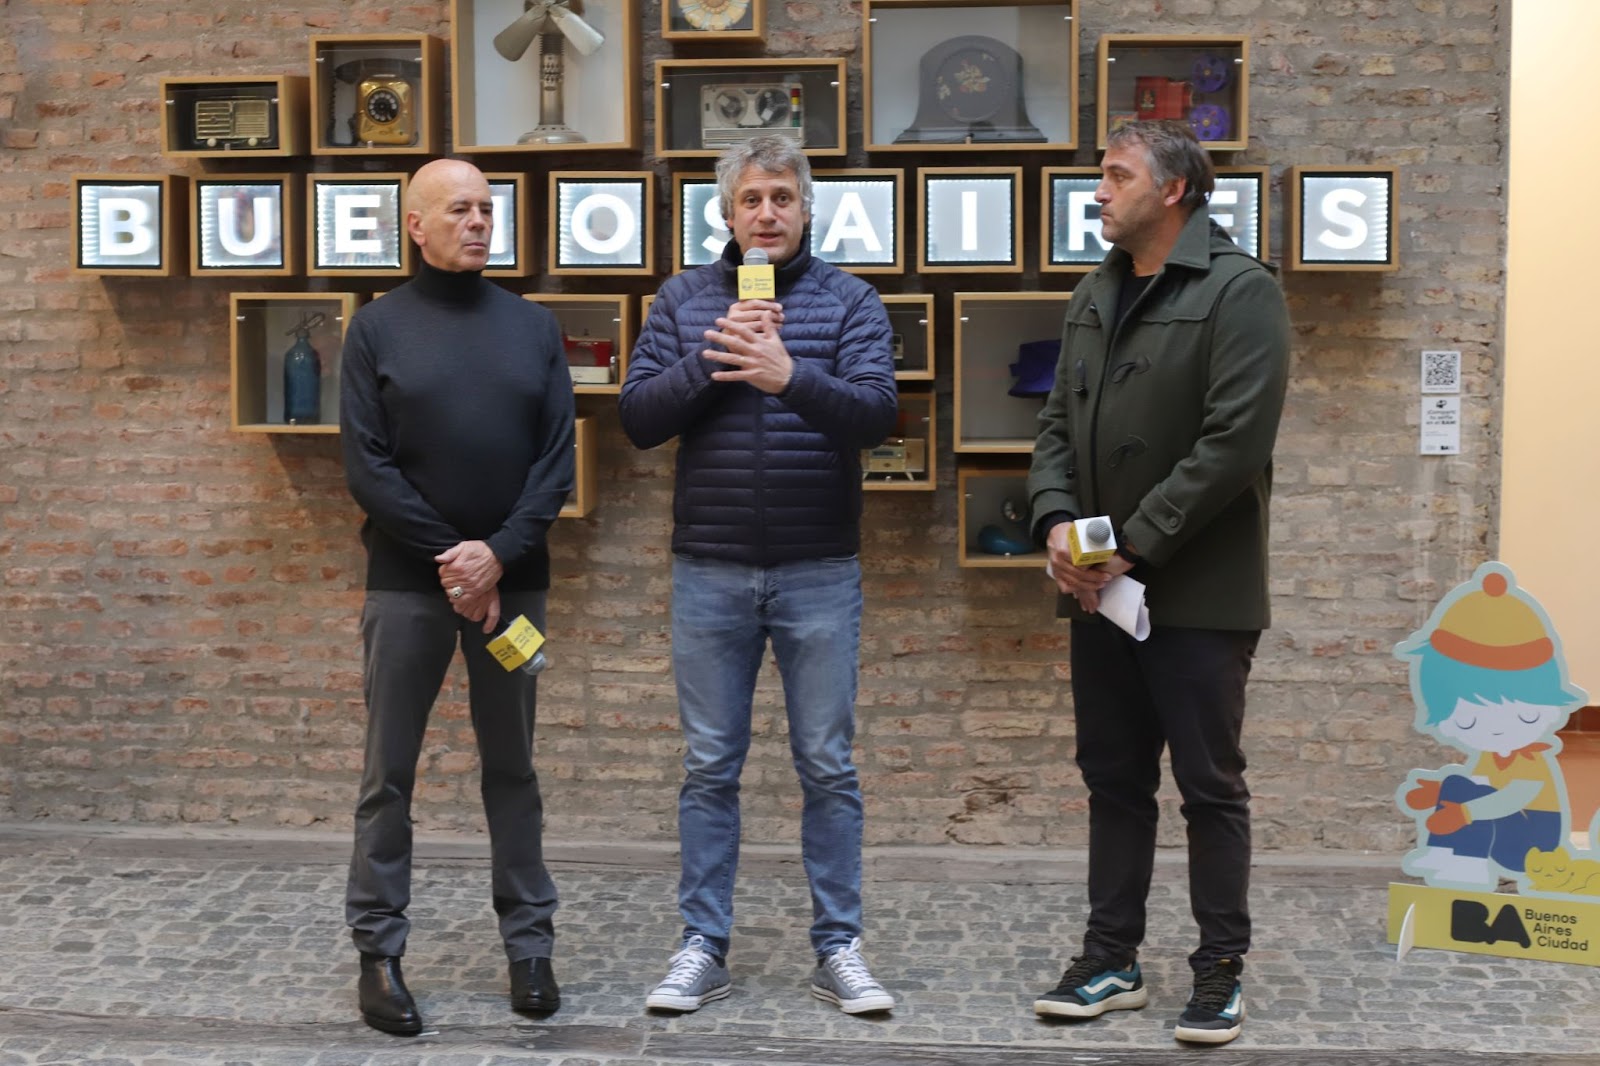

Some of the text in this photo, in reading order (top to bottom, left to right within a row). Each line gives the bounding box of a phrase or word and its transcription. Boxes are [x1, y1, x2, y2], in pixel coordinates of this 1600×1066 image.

[1451, 899, 1532, 949] BA
[1525, 908, 1578, 924] Buenos
[1533, 922, 1572, 936] Aires
[1537, 935, 1589, 951] Ciudad
